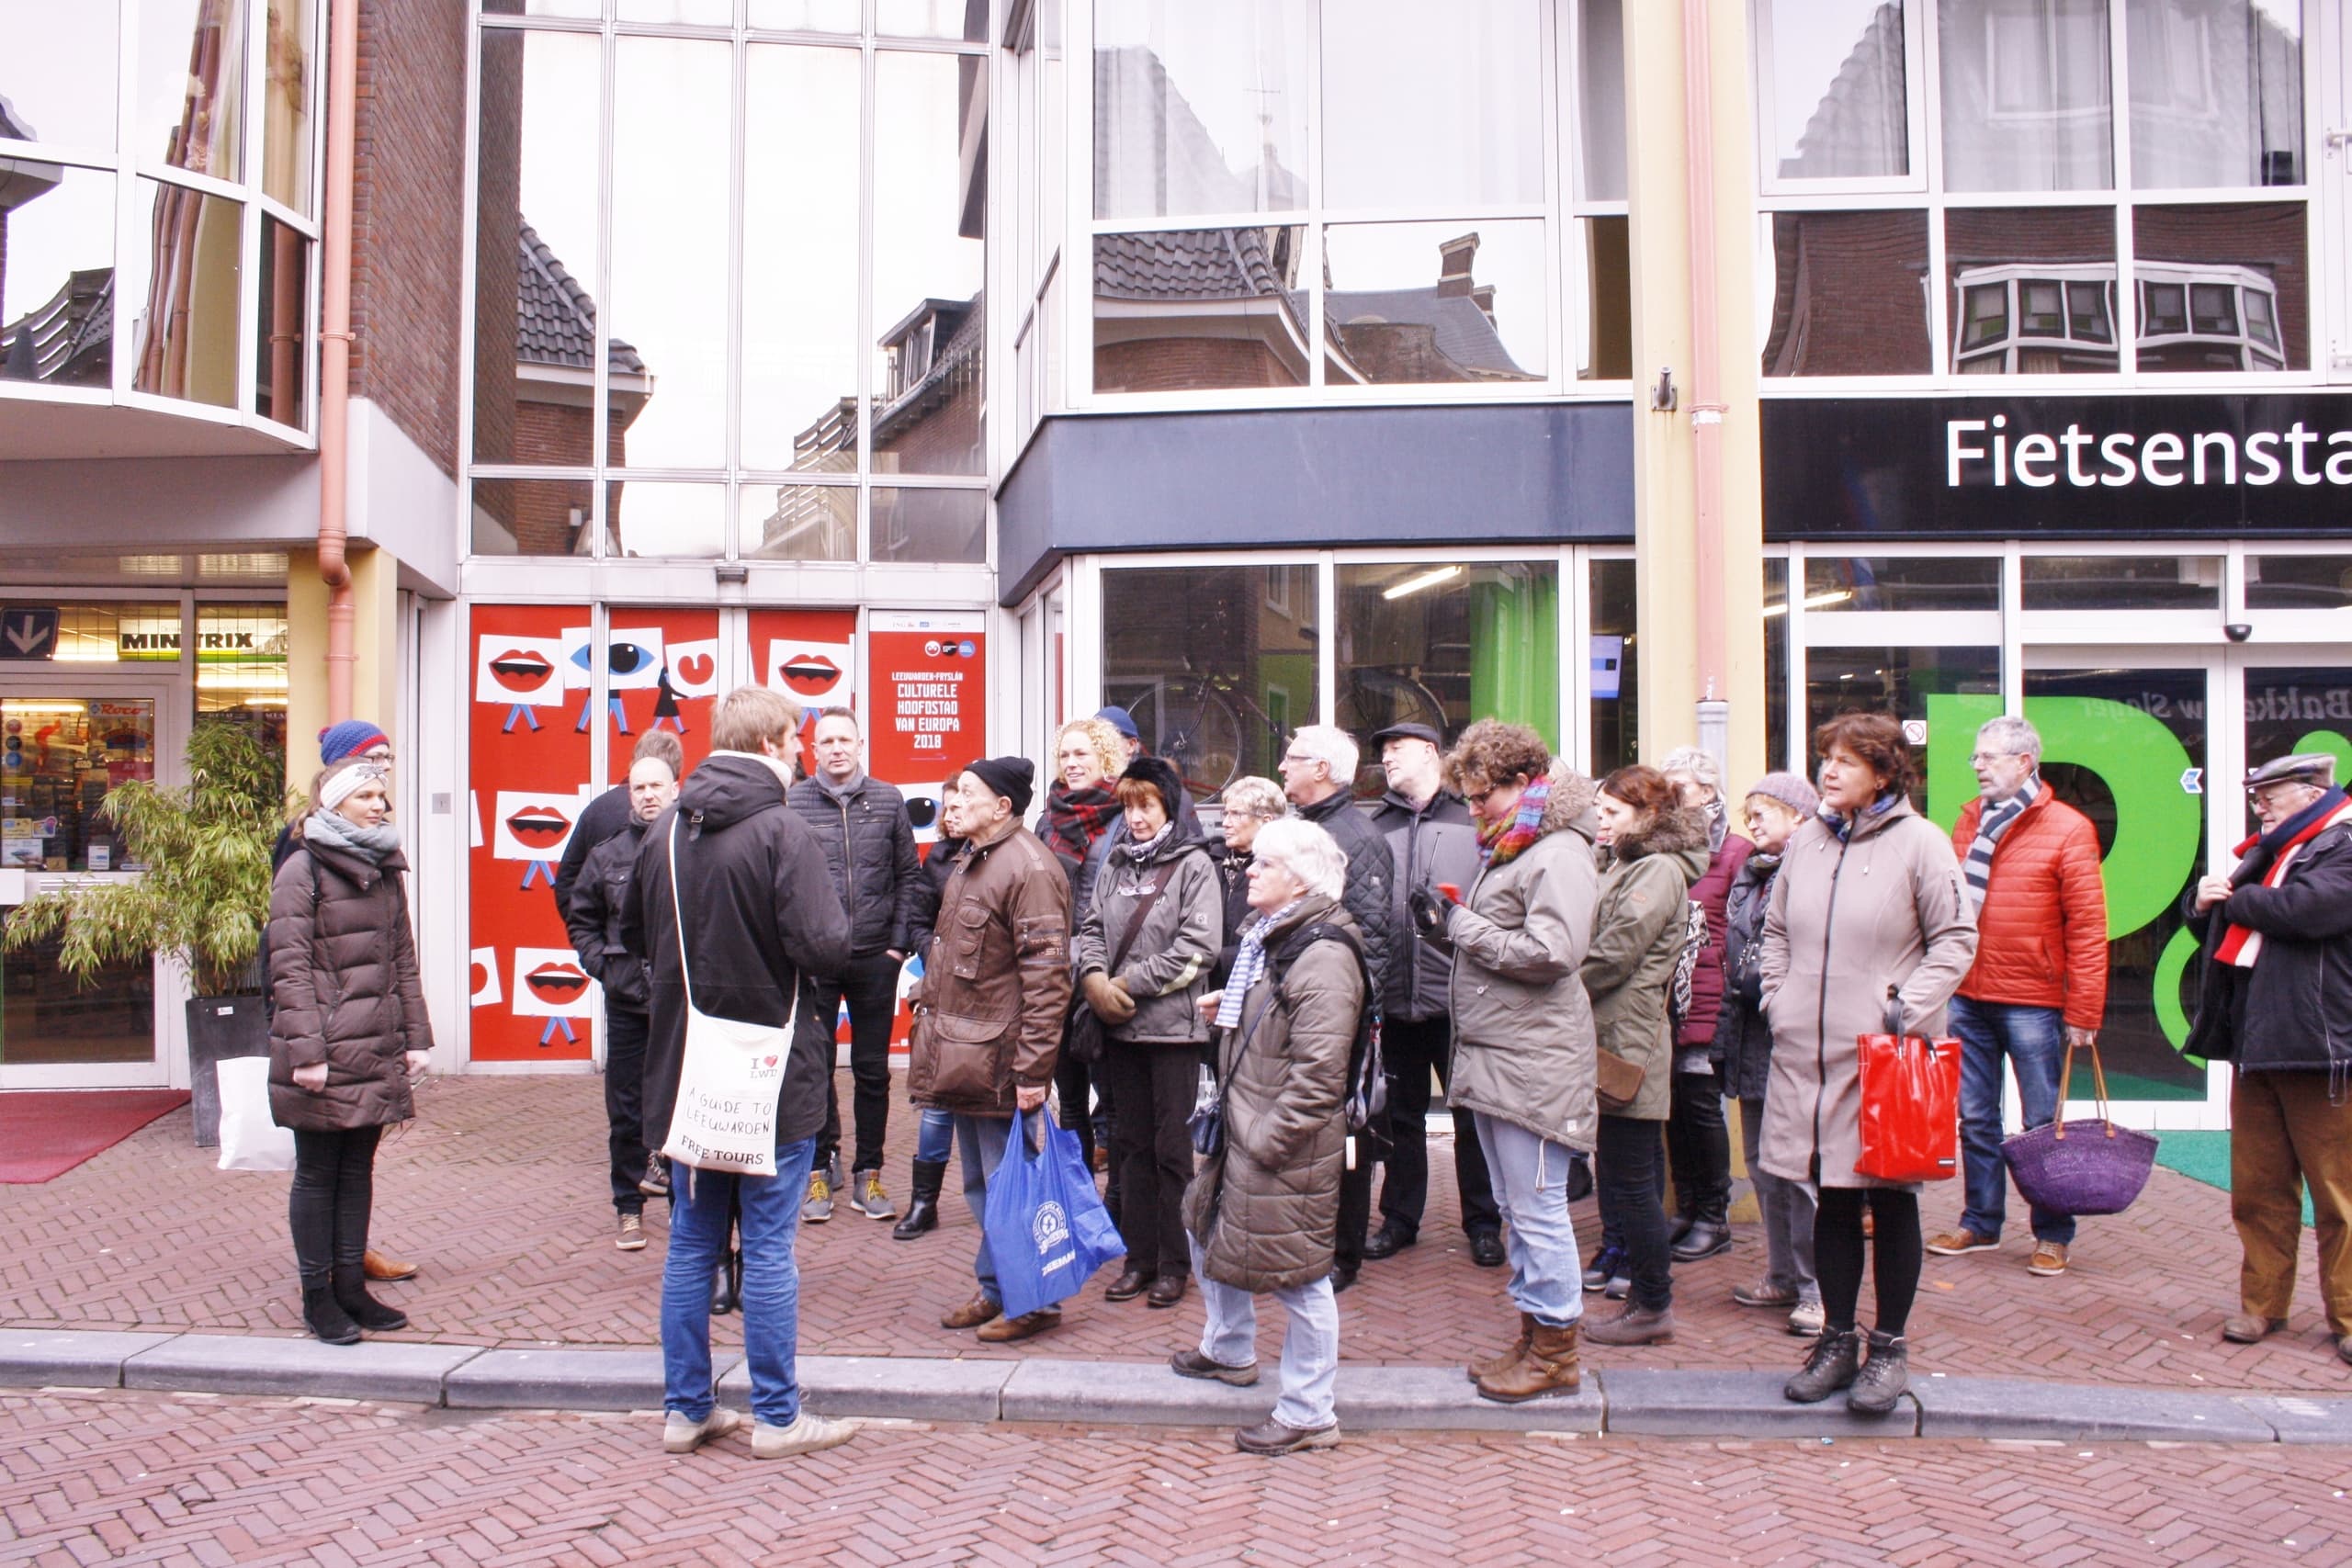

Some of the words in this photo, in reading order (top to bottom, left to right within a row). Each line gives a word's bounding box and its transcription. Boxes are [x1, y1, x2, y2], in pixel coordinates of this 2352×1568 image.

[1947, 414, 2352, 487] Fietsensta
[121, 633, 253, 649] MINRIX
[898, 683, 957, 698] CULTURELE
[897, 700, 958, 715] HOOFDSTAD
[895, 717, 915, 732] VAN
[918, 717, 960, 732] EUROPA
[913, 734, 942, 749] 2018
[682, 1135, 710, 1159] FREE
[714, 1150, 764, 1165] TOURS
